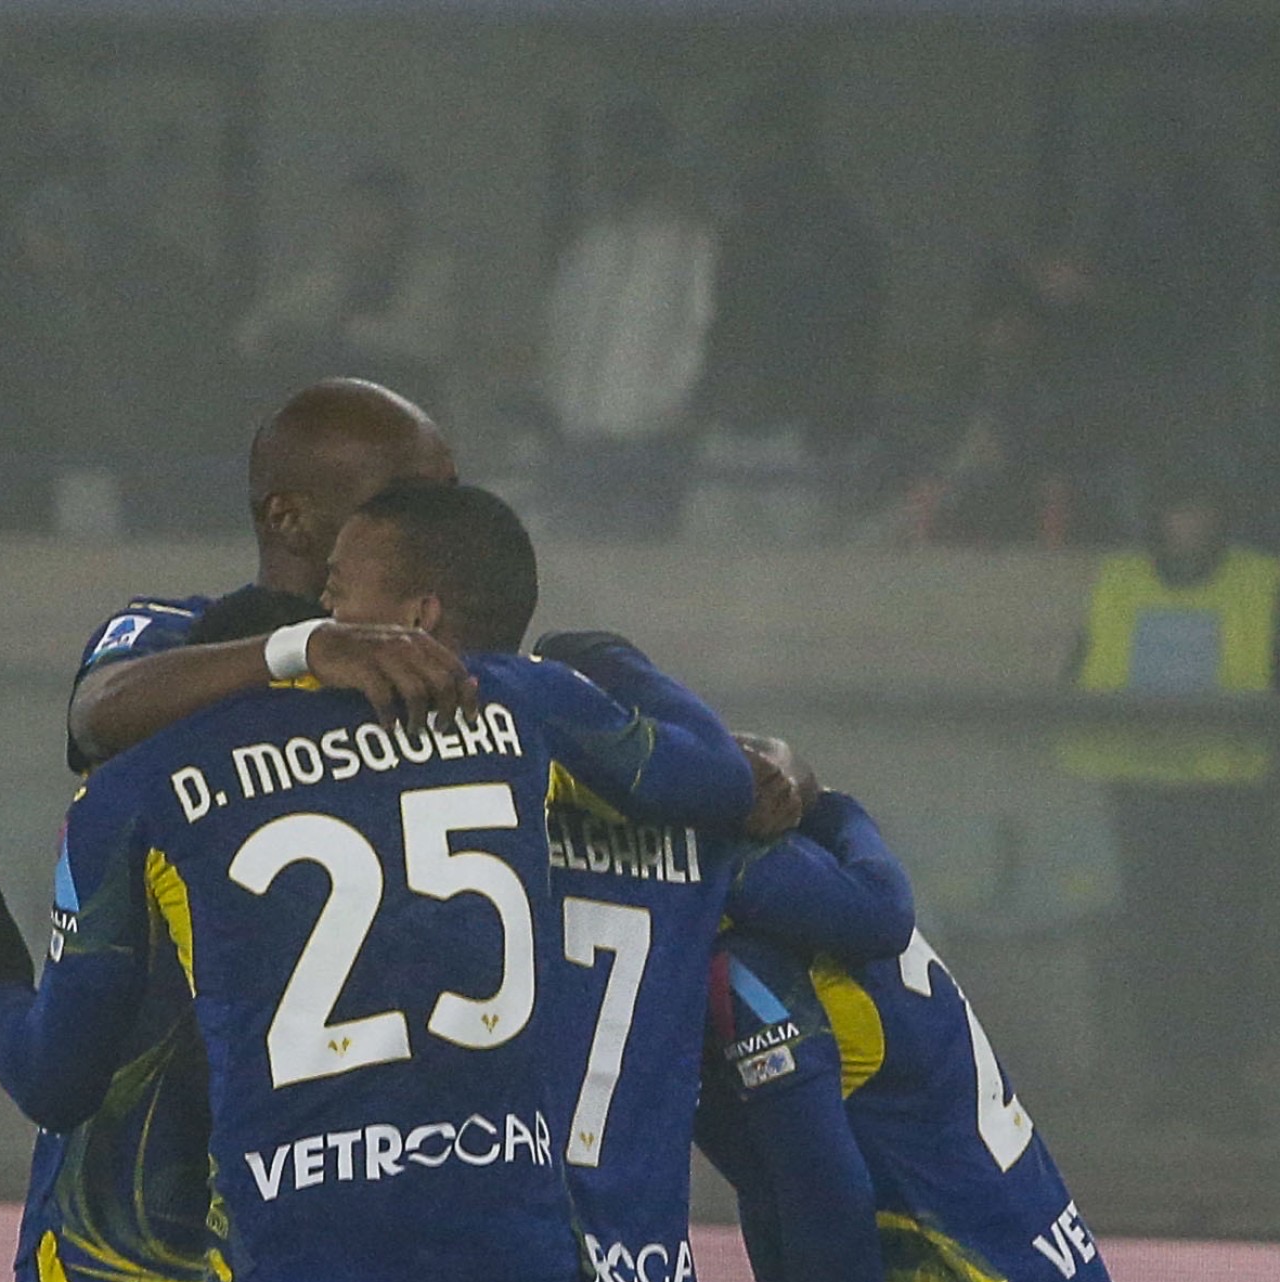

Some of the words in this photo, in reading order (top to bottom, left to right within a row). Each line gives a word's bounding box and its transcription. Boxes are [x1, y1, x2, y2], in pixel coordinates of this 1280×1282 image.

[171, 765, 228, 824] D.
[232, 702, 523, 799] MOSQUERA
[228, 782, 536, 1089] 25
[563, 896, 651, 1168] 7
[245, 1110, 554, 1201] VETROCAR
